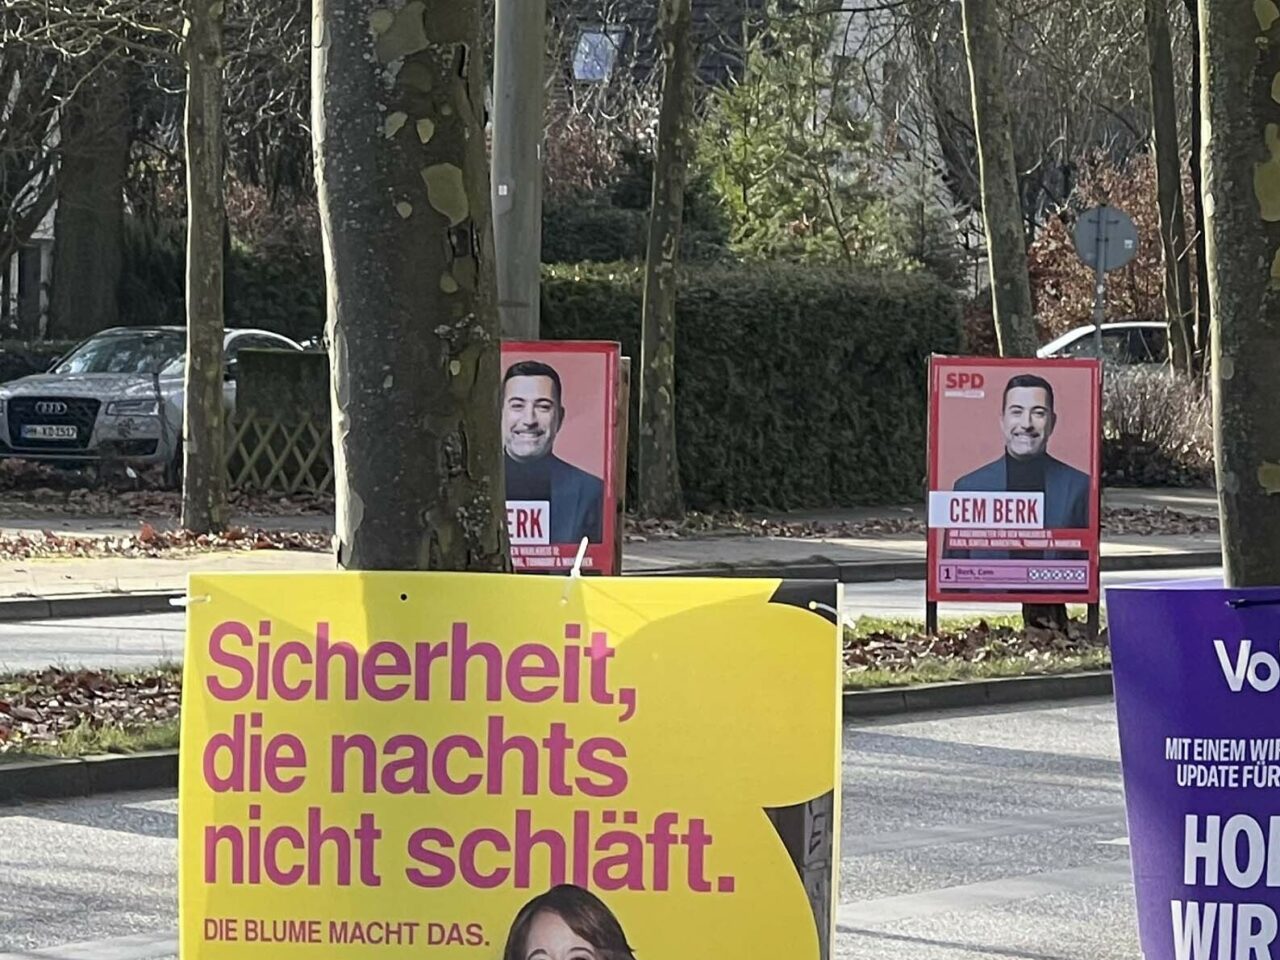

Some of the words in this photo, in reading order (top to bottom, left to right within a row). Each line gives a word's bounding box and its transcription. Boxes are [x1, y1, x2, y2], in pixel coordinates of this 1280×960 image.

[946, 373, 984, 389] SPD
[950, 498, 986, 523] CEM
[993, 498, 1039, 524] BERK
[944, 568, 952, 580] 1
[206, 620, 636, 722] Sicherheit,
[203, 712, 307, 793] die
[331, 716, 629, 797] nachts
[1165, 737, 1191, 760] MIT
[1198, 737, 1246, 761] EINEM
[1177, 764, 1239, 788] UPDATE
[1242, 761, 1280, 787] FÜR
[204, 804, 382, 886] nicht
[405, 809, 736, 893] schläft.
[204, 918, 239, 941] DIE
[244, 919, 322, 944] BLUME
[329, 921, 420, 946] MACHT
[427, 923, 491, 947] DAS.
